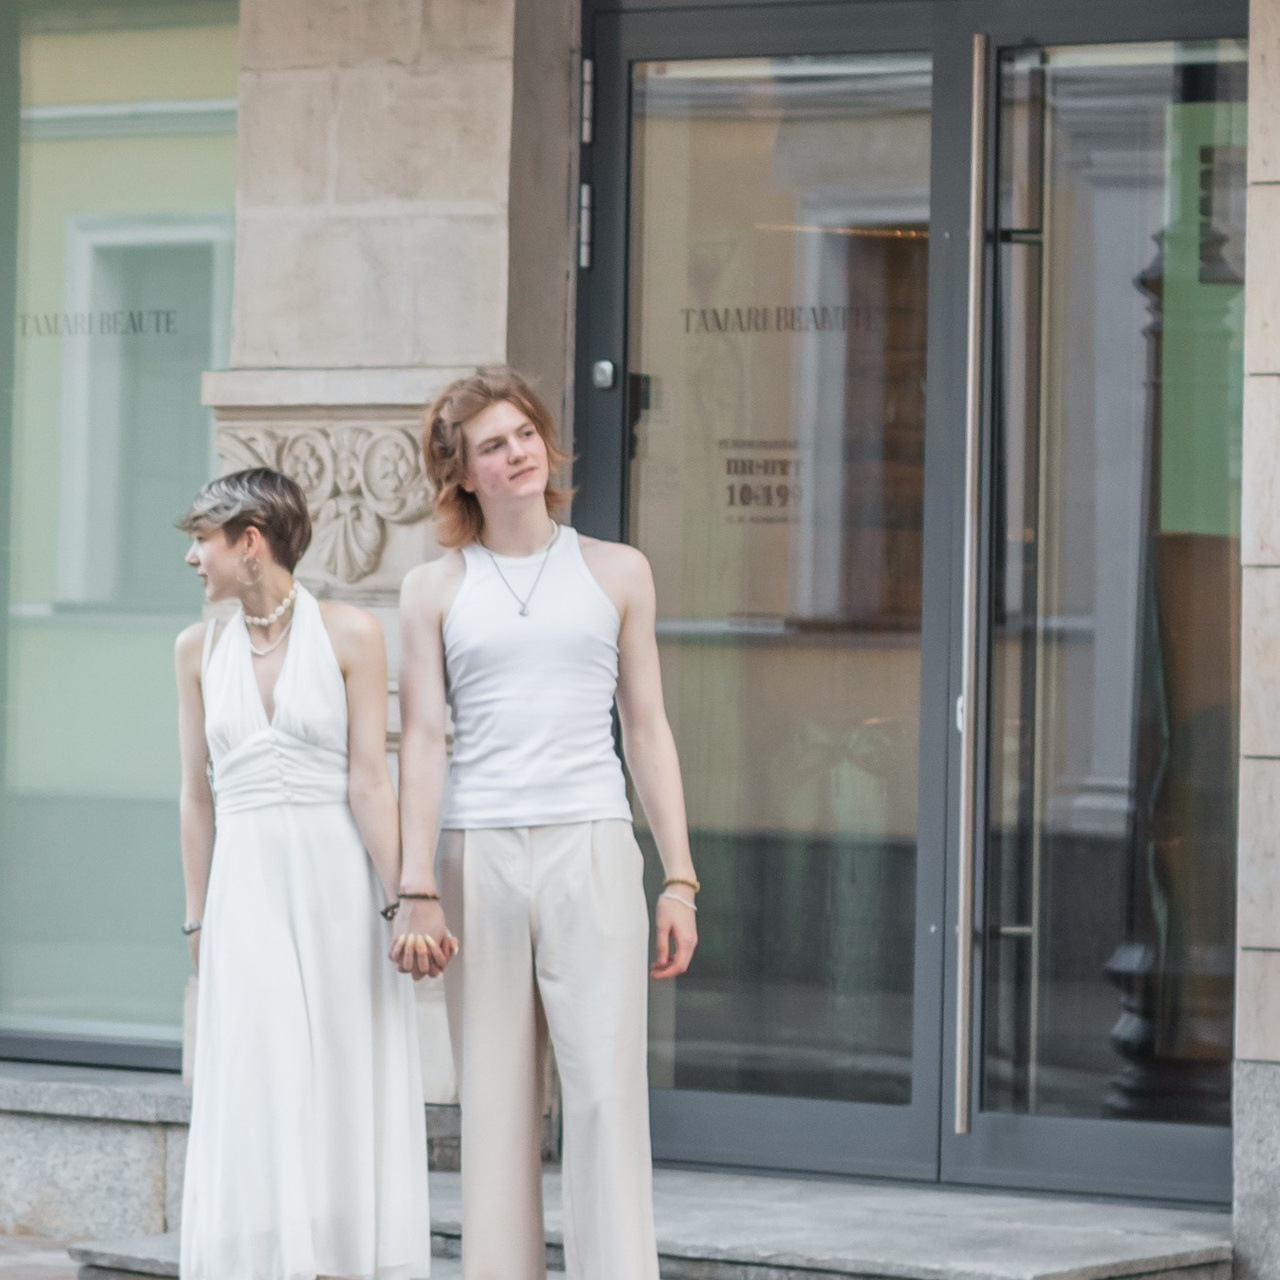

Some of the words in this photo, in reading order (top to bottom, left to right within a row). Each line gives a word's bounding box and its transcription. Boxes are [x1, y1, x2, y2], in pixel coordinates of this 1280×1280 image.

[19, 312, 93, 337] TAMARI
[99, 308, 178, 335] BEAUTE
[680, 306, 768, 334] TAMARI
